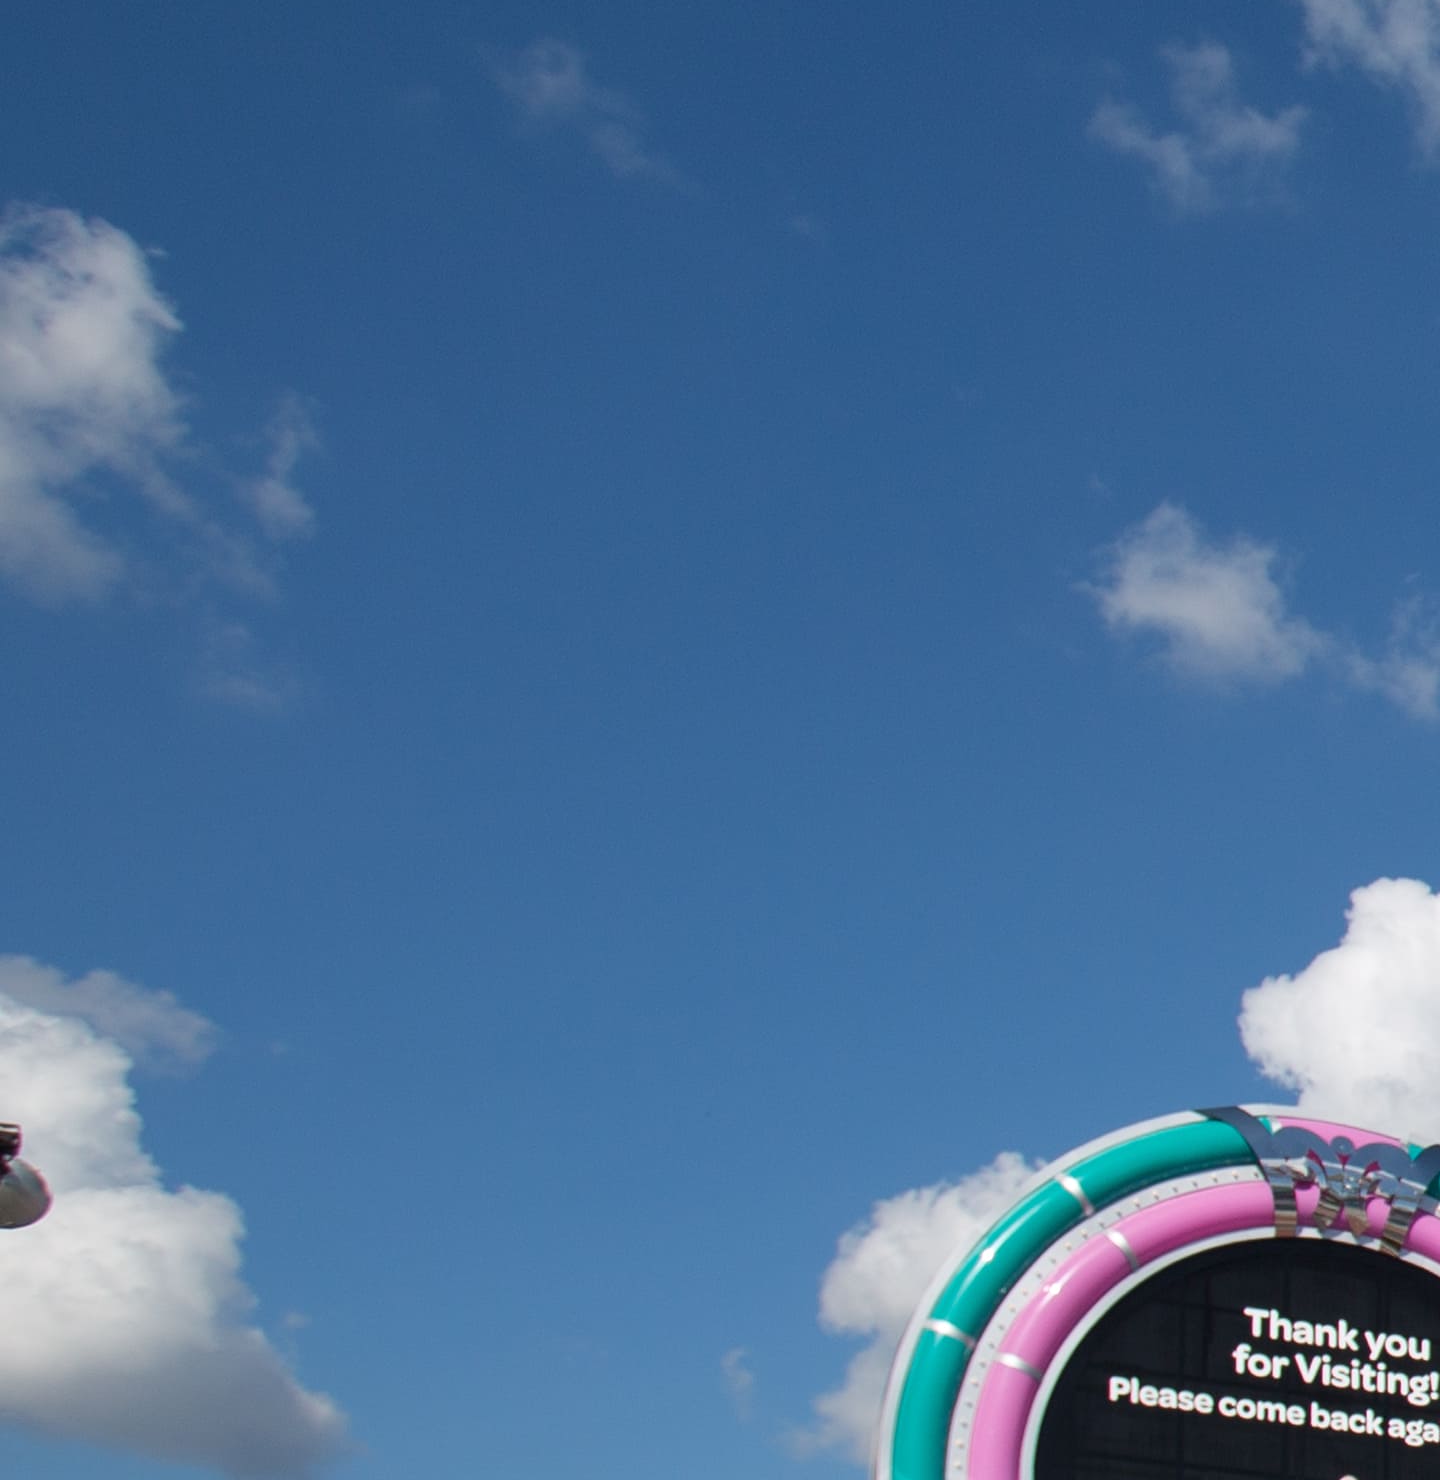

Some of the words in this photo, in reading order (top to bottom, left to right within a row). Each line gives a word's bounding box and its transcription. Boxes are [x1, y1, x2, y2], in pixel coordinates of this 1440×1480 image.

[1243, 1307, 1359, 1352] Thank
[1364, 1330, 1431, 1361] you
[1231, 1343, 1289, 1379] for
[1295, 1353, 1440, 1407] Visiting!
[1109, 1376, 1214, 1414] Please
[1218, 1396, 1306, 1426] come
[1310, 1401, 1383, 1436] back
